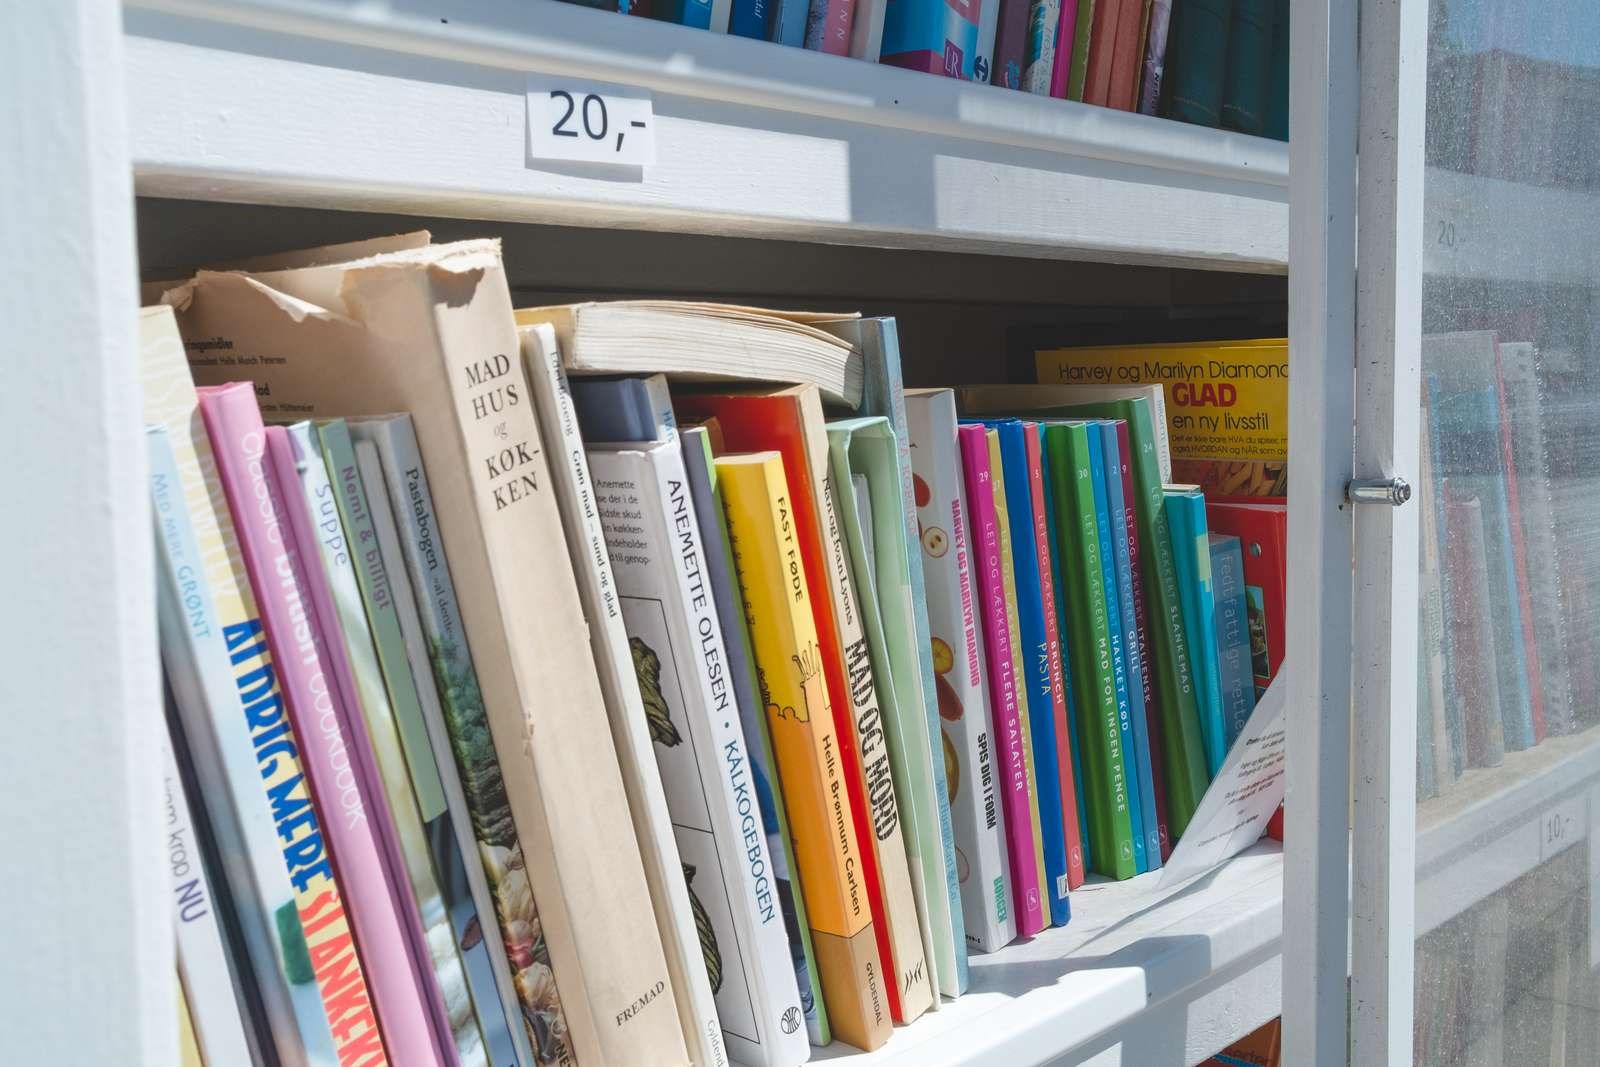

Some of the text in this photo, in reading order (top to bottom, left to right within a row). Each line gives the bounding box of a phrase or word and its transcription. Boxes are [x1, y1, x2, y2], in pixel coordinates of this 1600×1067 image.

[550, 90, 646, 151] 20,-
[465, 354, 510, 388] MAD
[1058, 362, 1112, 382] Harvey
[1118, 366, 1140, 383] og
[1144, 361, 1204, 383] Marilyn
[472, 384, 519, 420] HUS
[558, 384, 574, 436] Broeng
[1172, 383, 1237, 408] GLAD
[494, 421, 508, 439] og
[1172, 412, 1269, 433] en ny livsstil
[597, 480, 635, 489] Anemette
[979, 470, 989, 483] 29
[1079, 469, 1088, 480] 30
[1112, 465, 1118, 474] 2
[1121, 464, 1127, 474] 9
[493, 471, 538, 511] KEN
[581, 489, 594, 519] mad
[315, 482, 348, 567] Suppe
[342, 465, 390, 610] Nemt & billigt
[406, 466, 438, 571] Pastabogen
[952, 498, 966, 549] HARVEY
[1099, 512, 1108, 536] LET
[1115, 509, 1124, 532] LET
[1125, 507, 1134, 530] LET
[592, 535, 605, 567] sund
[823, 477, 833, 512] Nan
[828, 515, 841, 537] og
[839, 573, 853, 626] Lyons
[957, 550, 968, 569] OG
[1101, 542, 1110, 566] OG
[1119, 538, 1128, 560] OG
[1128, 536, 1137, 556] OG
[178, 565, 211, 638] GRØNT
[600, 571, 610, 589] og
[960, 571, 975, 627] MARILYN
[1152, 486, 1160, 507] LET
[1170, 605, 1190, 694] SLANKEMAD
[604, 591, 617, 618] glad
[1038, 514, 1063, 703] LET OG LÆKKERT BRUNCH
[241, 431, 287, 546] Classic
[274, 550, 321, 665] british
[308, 671, 368, 830] cookbook
[1128, 630, 1139, 673] GRILL
[966, 626, 981, 688] DIAMOND
[986, 522, 1024, 791] LET OG LÆKKERT FLERE SALATER
[1038, 642, 1051, 697] PASTA
[1085, 514, 1126, 812] LET OG LÆKKERT MAD FOR INGEN PENGE
[1112, 635, 1125, 693] HAKKET
[1137, 627, 1150, 704] ITALIENSK
[668, 479, 776, 924] ANEMETTE OLESEN KÅLKOGEBOGEN
[778, 497, 861, 917] FAST FØDE Helle Brønnum Carlsen
[1119, 700, 1129, 731] KØD
[1231, 677, 1247, 730] rette
[222, 617, 299, 780] ALDRIG
[266, 772, 334, 893] MERE
[845, 636, 899, 842] MAD OG MORD
[977, 732, 989, 763] SPIS
[980, 762, 993, 787] DIG
[984, 794, 998, 830] FORM
[169, 828, 191, 878] krop
[174, 878, 208, 923] NU
[993, 875, 1008, 924] BORGEN
[615, 980, 666, 1027] FREMAD
[866, 963, 882, 1026] GYLDENDAL
[556, 1043, 571, 1067] NE
